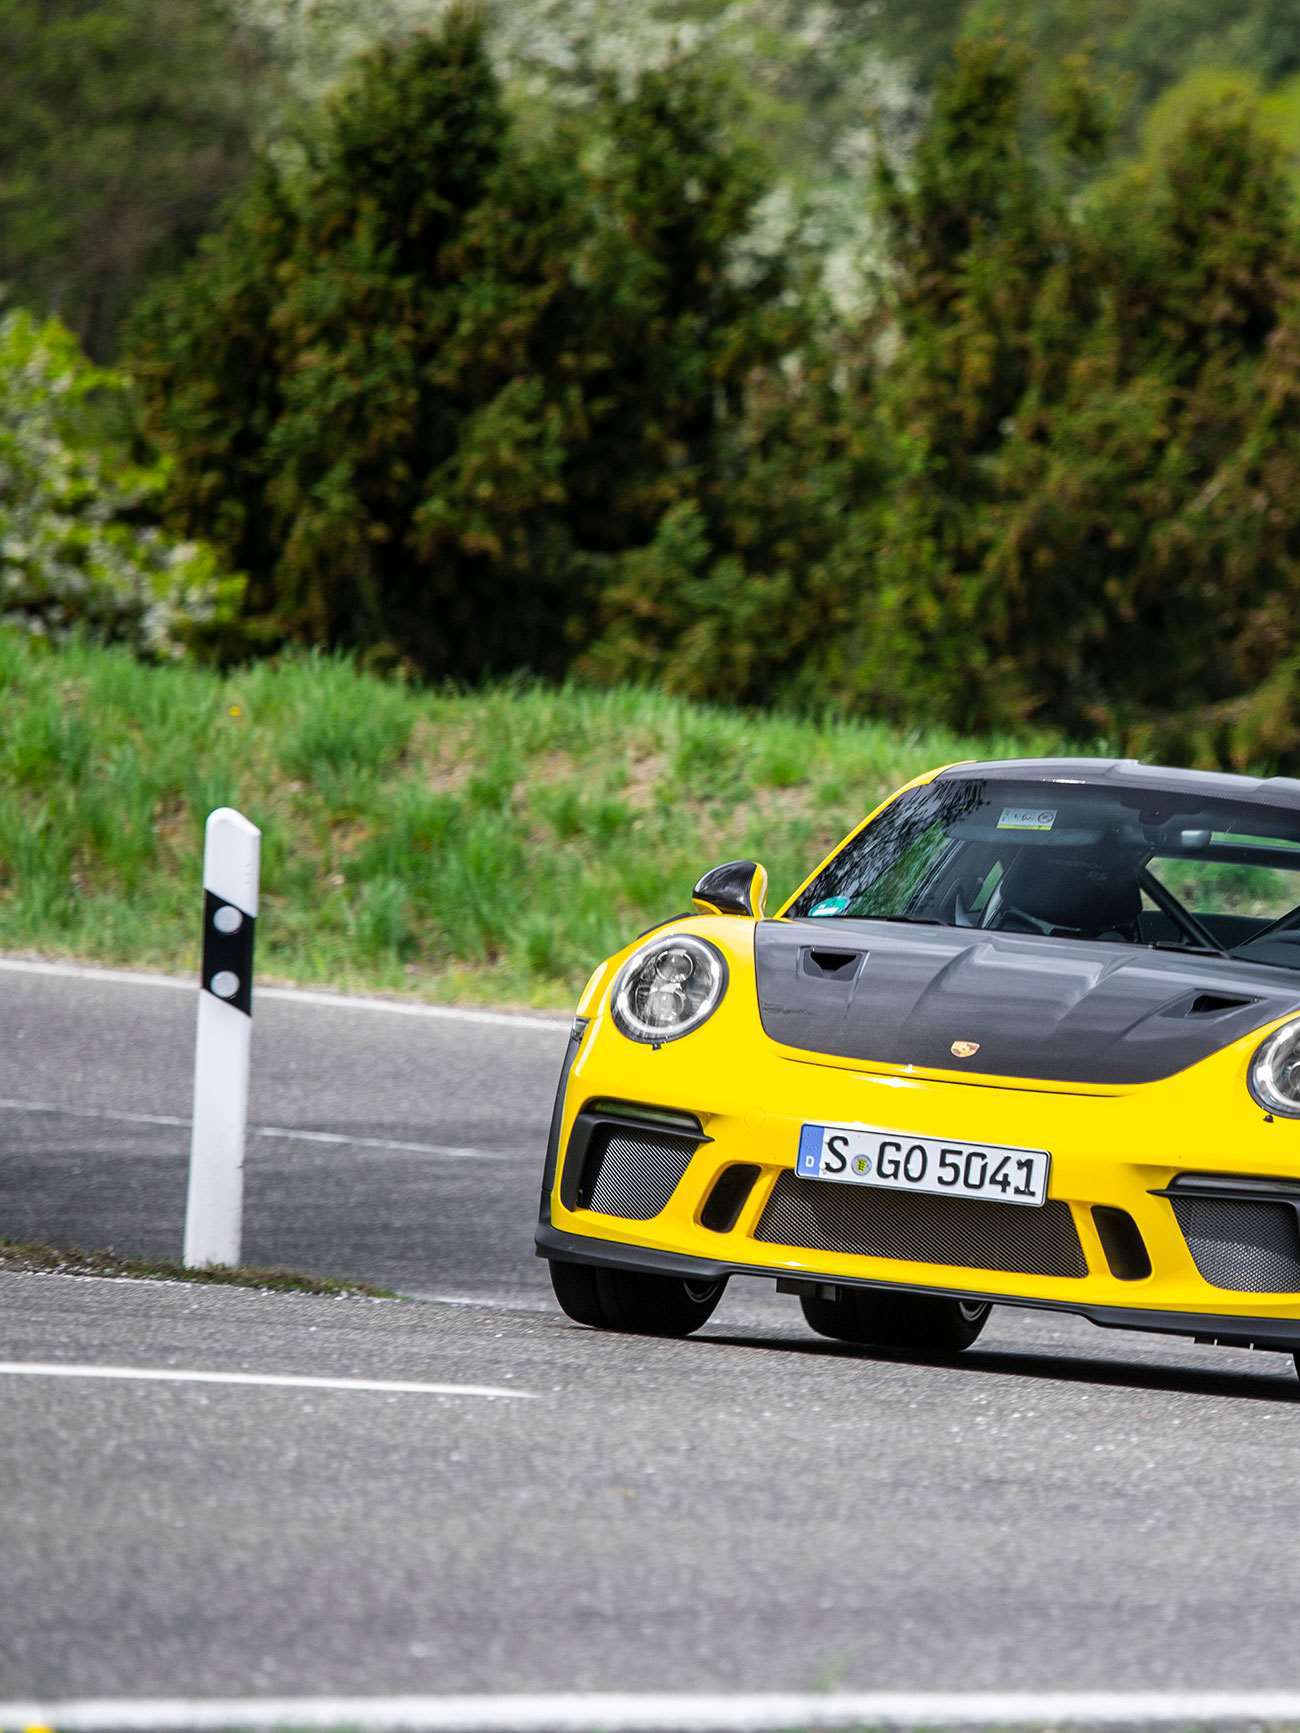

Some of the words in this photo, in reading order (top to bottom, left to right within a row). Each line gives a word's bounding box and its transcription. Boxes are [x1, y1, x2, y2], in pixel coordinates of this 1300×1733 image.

[805, 1155, 815, 1168] D
[825, 1136, 849, 1173] S
[877, 1141, 928, 1183] GO
[937, 1150, 1036, 1197] 5041
